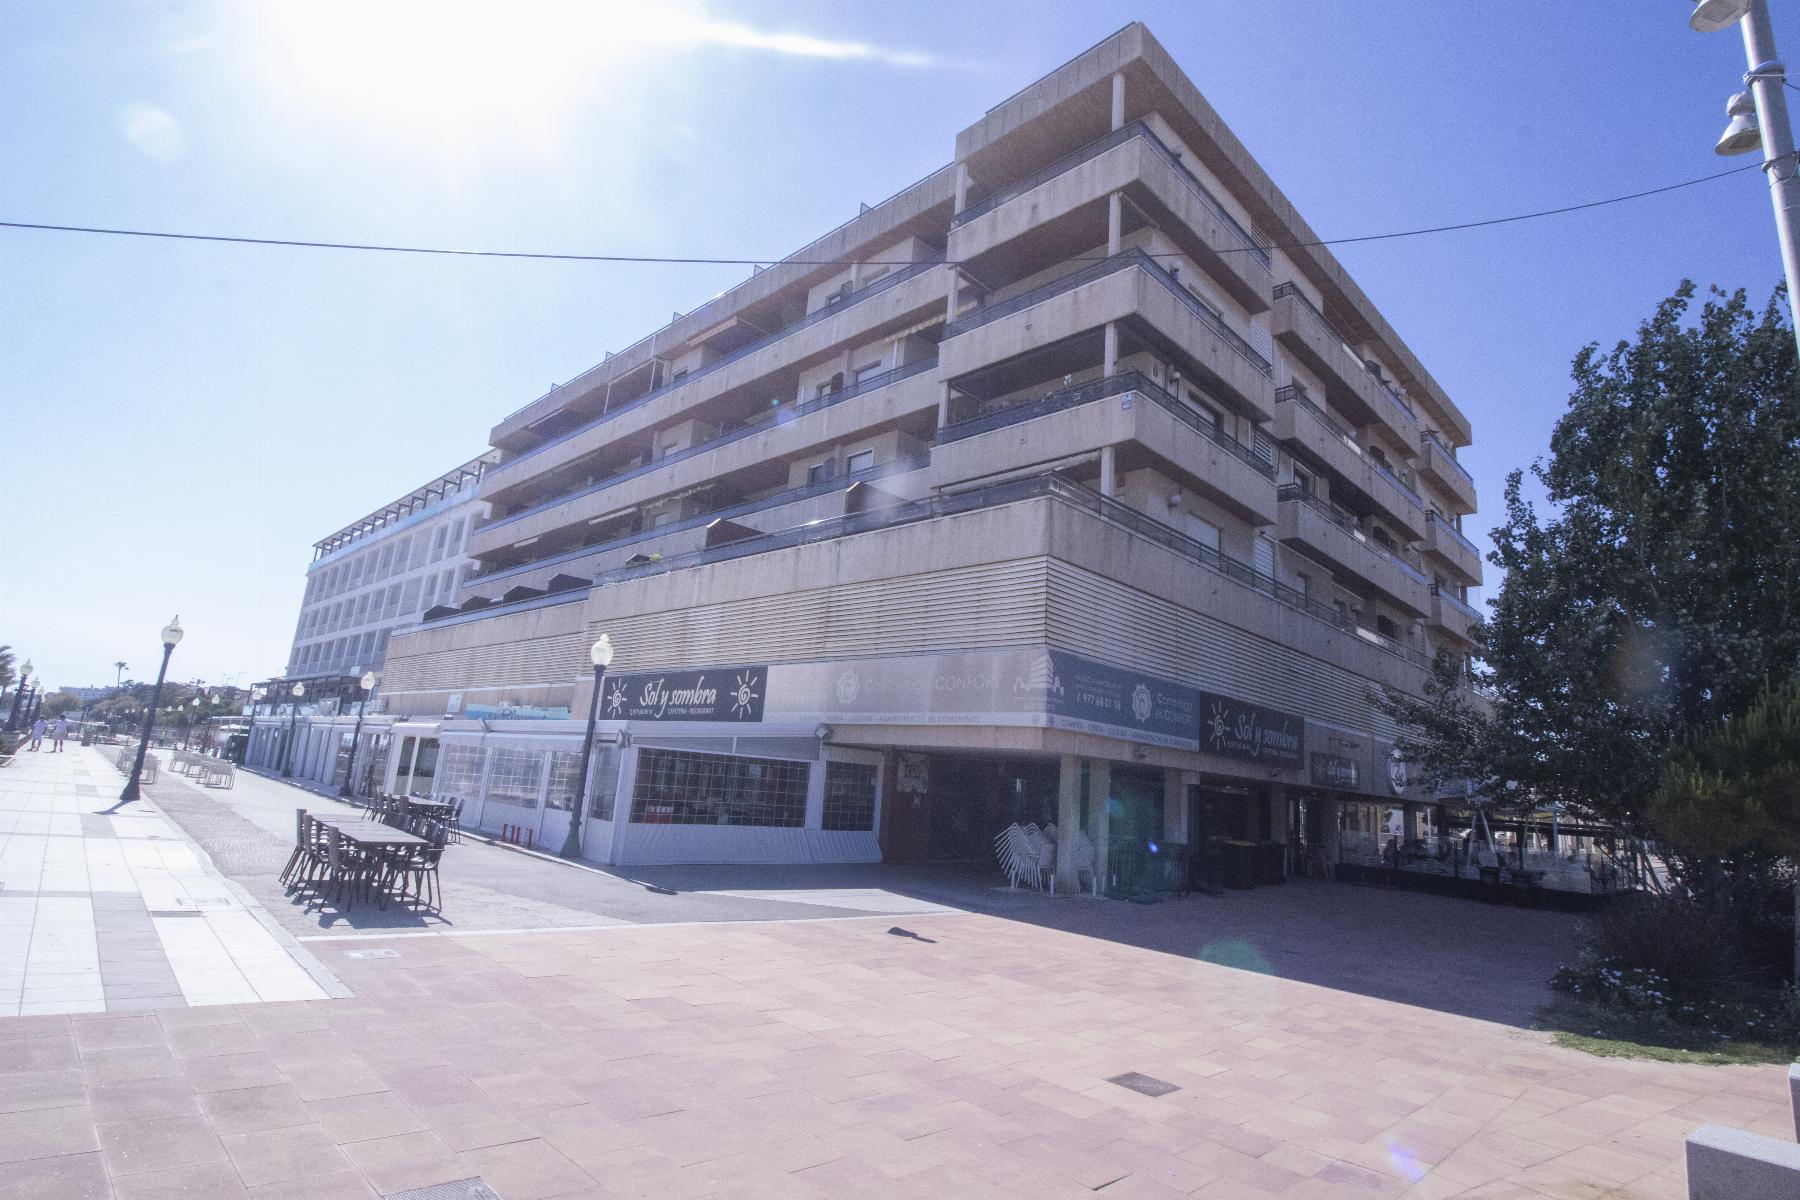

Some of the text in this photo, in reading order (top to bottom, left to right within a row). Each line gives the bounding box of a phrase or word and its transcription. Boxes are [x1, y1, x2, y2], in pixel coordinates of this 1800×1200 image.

[640, 676, 717, 719] Sol y sombra
[1235, 712, 1298, 758] Sol y sombra
